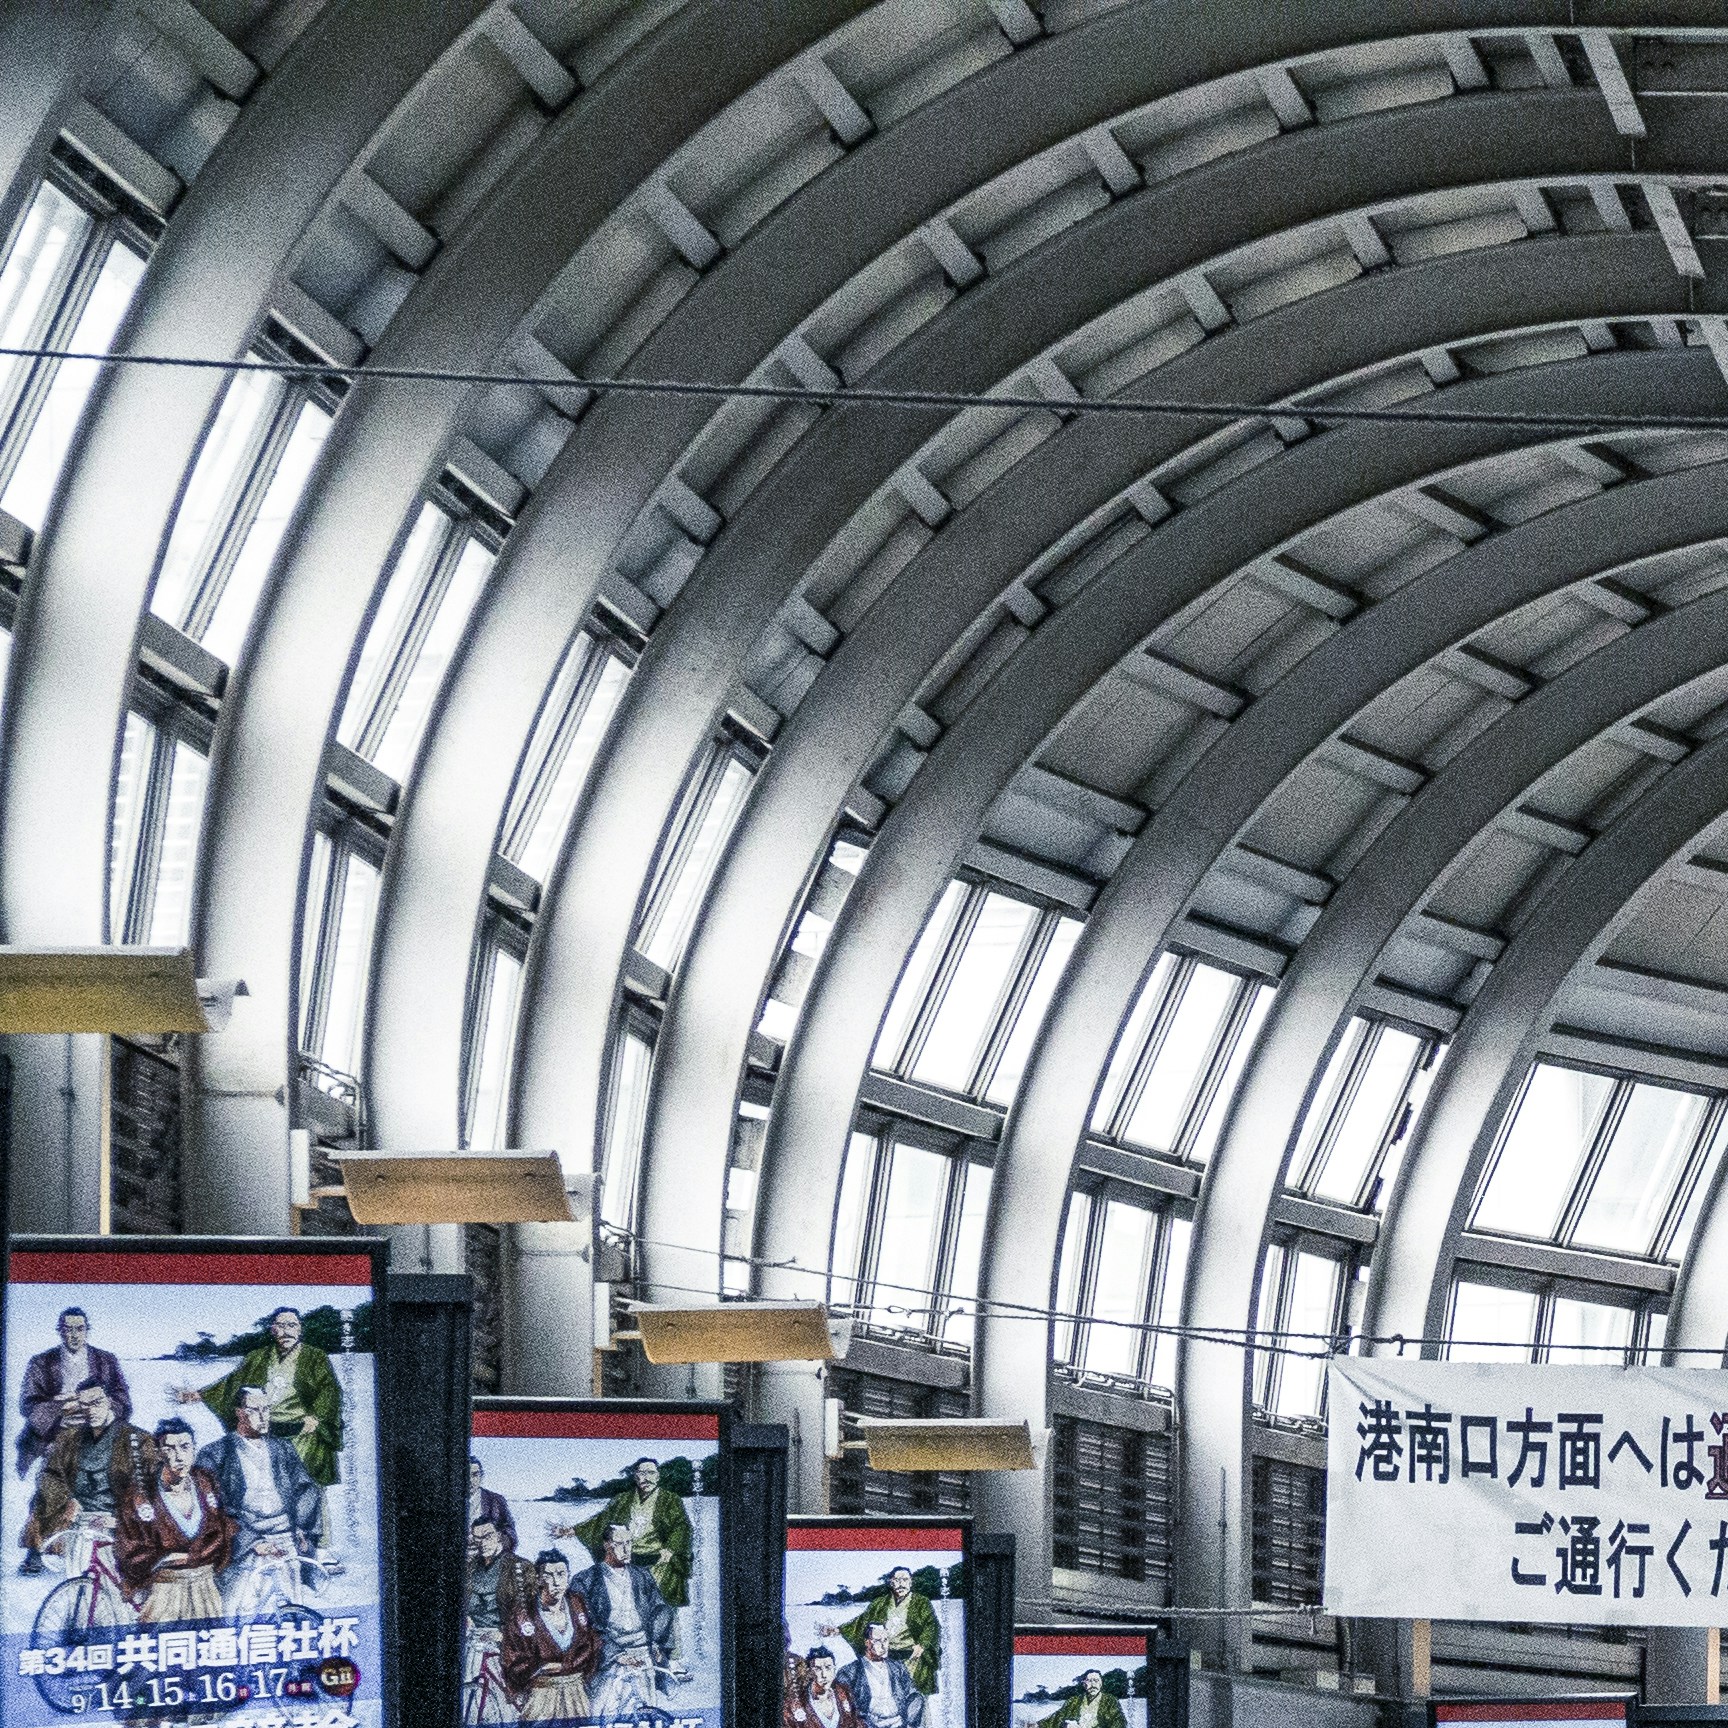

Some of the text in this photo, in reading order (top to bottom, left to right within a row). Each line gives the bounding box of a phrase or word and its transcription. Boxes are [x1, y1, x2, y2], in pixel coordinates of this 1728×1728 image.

[20, 1616, 361, 1676] 第34回 共同通信社杯
[146, 1677, 184, 1707] 15
[199, 1673, 237, 1702] 16
[252, 1668, 288, 1698] 17
